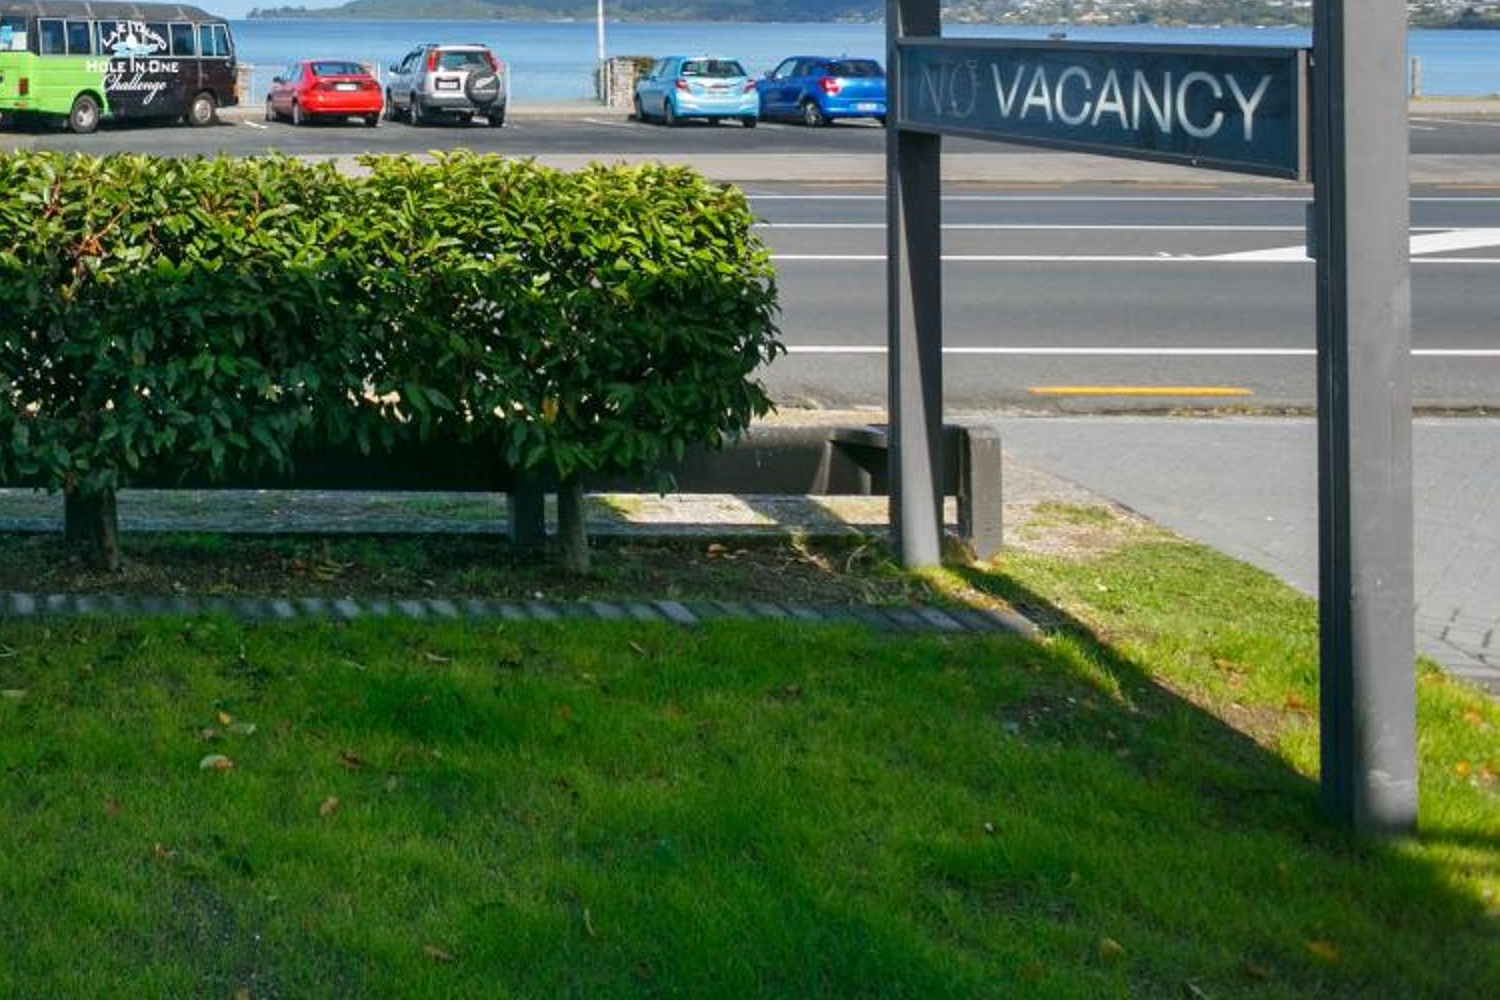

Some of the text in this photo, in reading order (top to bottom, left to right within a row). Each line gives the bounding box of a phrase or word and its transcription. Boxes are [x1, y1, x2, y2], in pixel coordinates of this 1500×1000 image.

[85, 58, 180, 73] HOLE IN ONE
[101, 71, 167, 105] Challenge
[920, 62, 1273, 141] NO VACANCY
